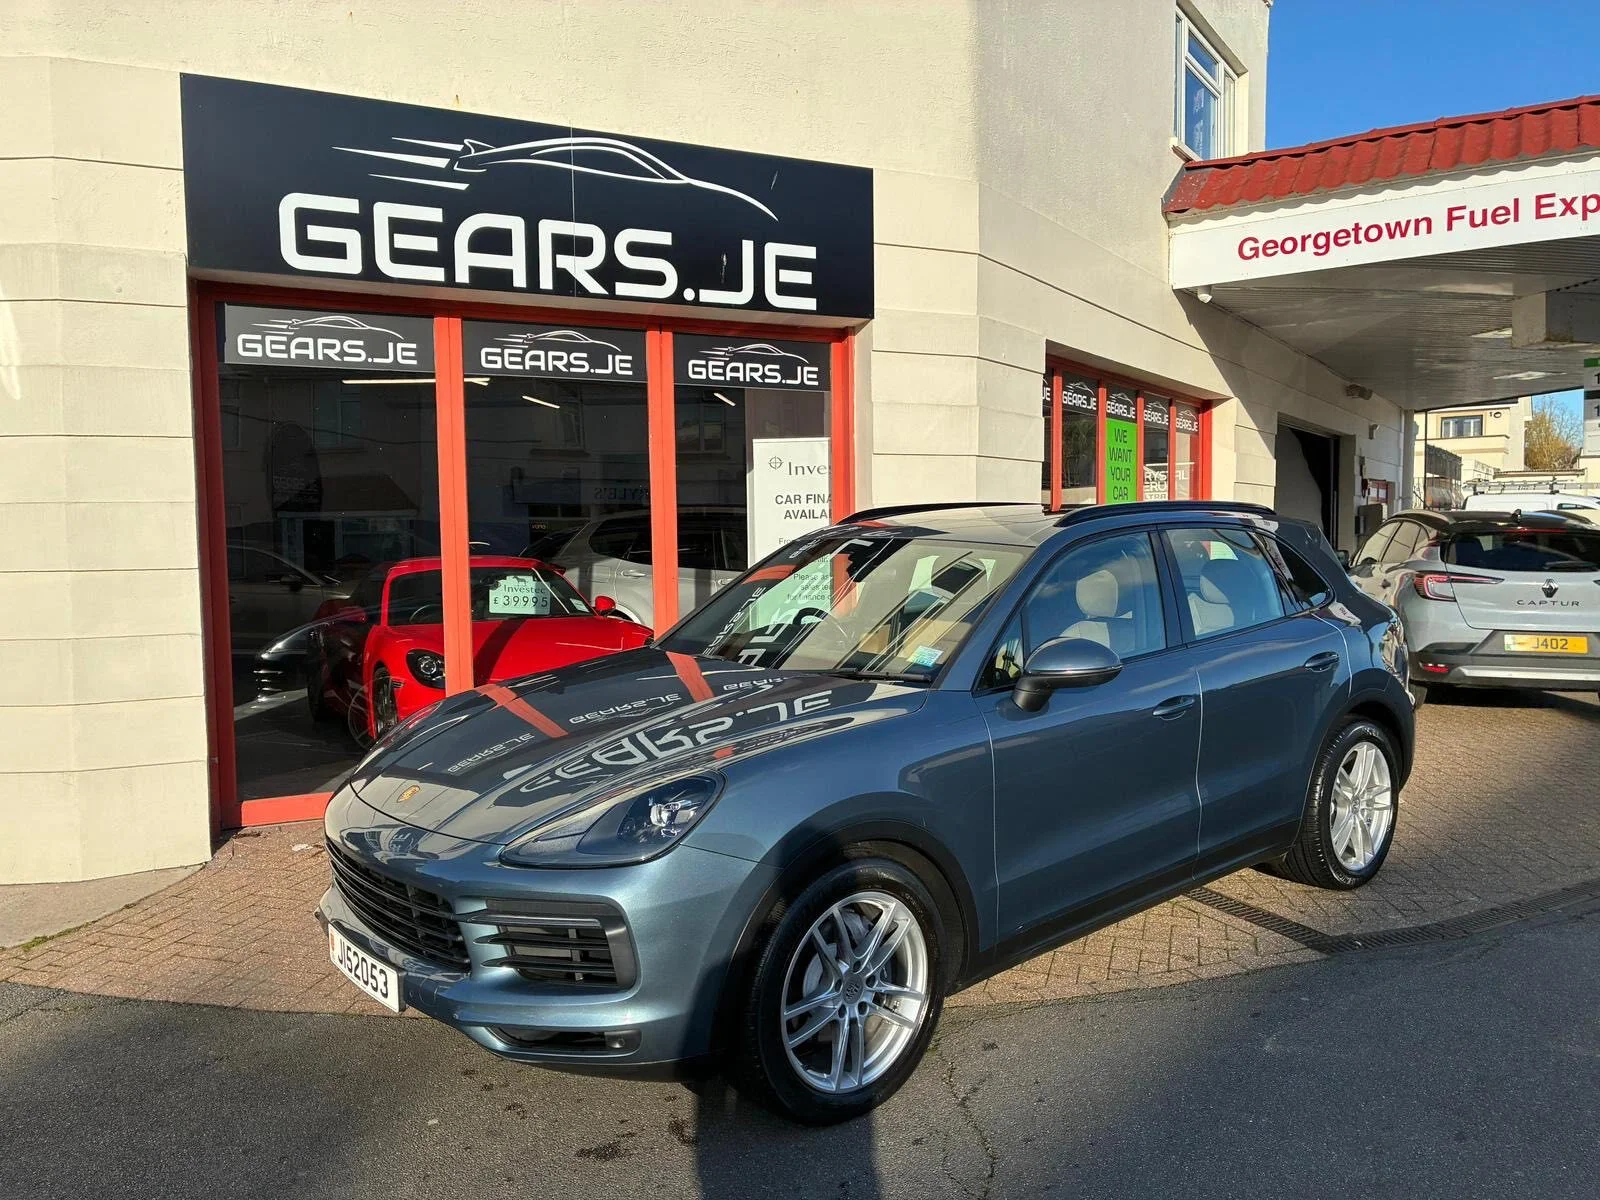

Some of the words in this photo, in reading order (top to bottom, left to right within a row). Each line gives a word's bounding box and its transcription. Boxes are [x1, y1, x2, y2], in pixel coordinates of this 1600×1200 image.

[1238, 216, 1433, 261] Georgetown
[1446, 198, 1519, 232] Fuel
[278, 191, 819, 312] GEARS.JE
[237, 334, 418, 365] GEARS.JE
[480, 347, 633, 376] GEARS.JE
[688, 359, 819, 386] GEARS.JE
[1114, 428, 1128, 443] WE
[1110, 447, 1132, 463] WANT
[1111, 466, 1131, 482] YOUR
[775, 494, 802, 505] CAR
[1113, 486, 1128, 500] CAR
[503, 584, 546, 594] Investec
[503, 595, 548, 608] 39995
[1531, 637, 1569, 650] J402
